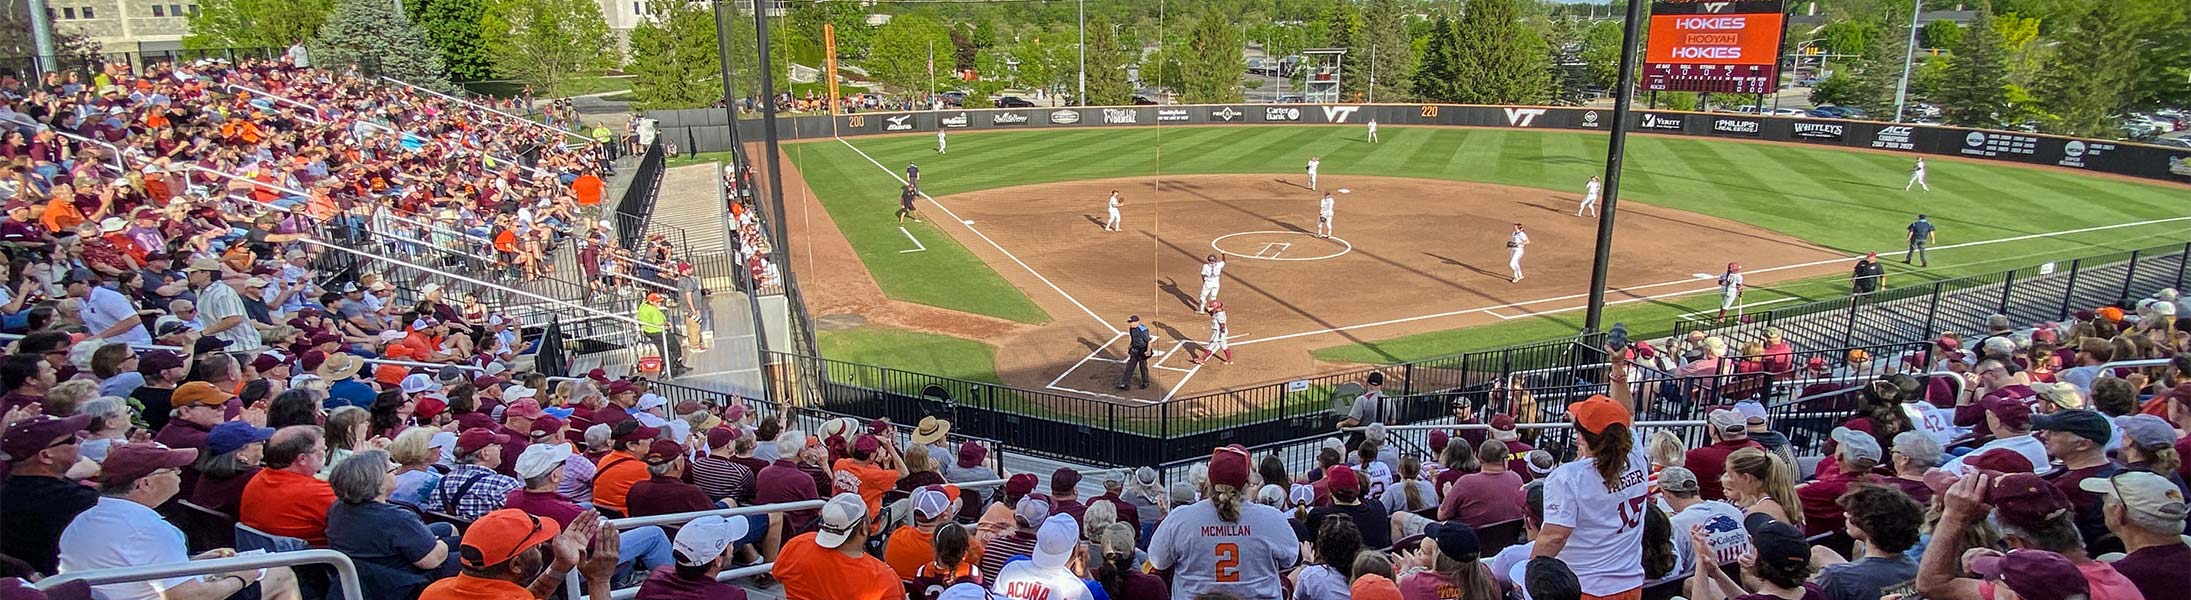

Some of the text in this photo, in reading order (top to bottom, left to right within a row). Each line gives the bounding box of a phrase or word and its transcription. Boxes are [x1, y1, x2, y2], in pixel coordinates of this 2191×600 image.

[1676, 17, 1746, 30] HOKIES
[1687, 34, 1736, 43] HOOYAH
[1672, 47, 1742, 59] HOKIES
[1321, 105, 1360, 123] VT
[1421, 106, 1438, 117] 220
[1504, 108, 1547, 127] VT
[848, 116, 865, 128] 200
[1719, 119, 1755, 128] PHILLIPS
[1877, 126, 1914, 135] ACC
[1923, 414, 1945, 433] 42
[1616, 494, 1648, 534] 15
[1201, 525, 1251, 536] MCMILLAN
[1215, 542, 1240, 583] 2
[1006, 580, 1051, 600] ACUÑA
